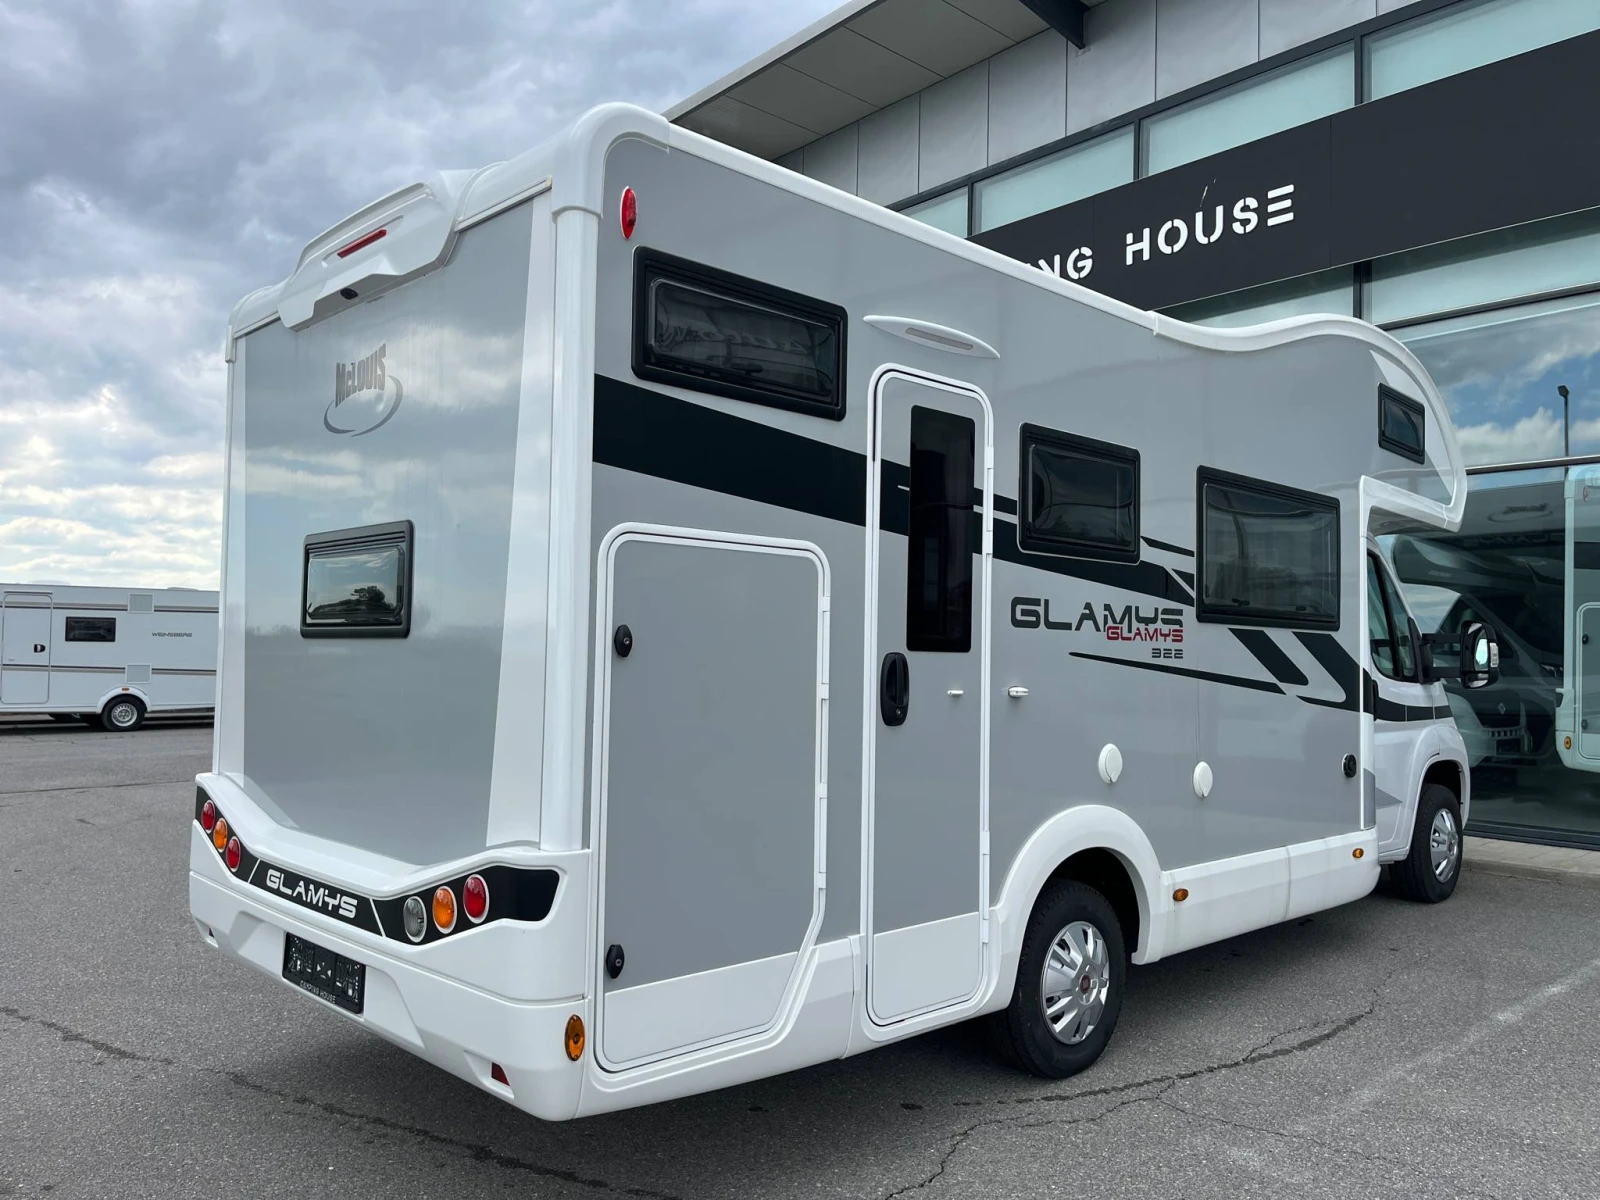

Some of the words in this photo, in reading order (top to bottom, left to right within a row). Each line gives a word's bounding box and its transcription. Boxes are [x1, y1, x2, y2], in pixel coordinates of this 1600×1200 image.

[1026, 246, 1093, 280] NG
[1125, 183, 1295, 266] HOUSE
[1010, 596, 1183, 634] GLAMYS
[1106, 625, 1184, 643] GLAMYS
[1151, 647, 1184, 659] 322
[266, 868, 358, 919] GLAMYS
